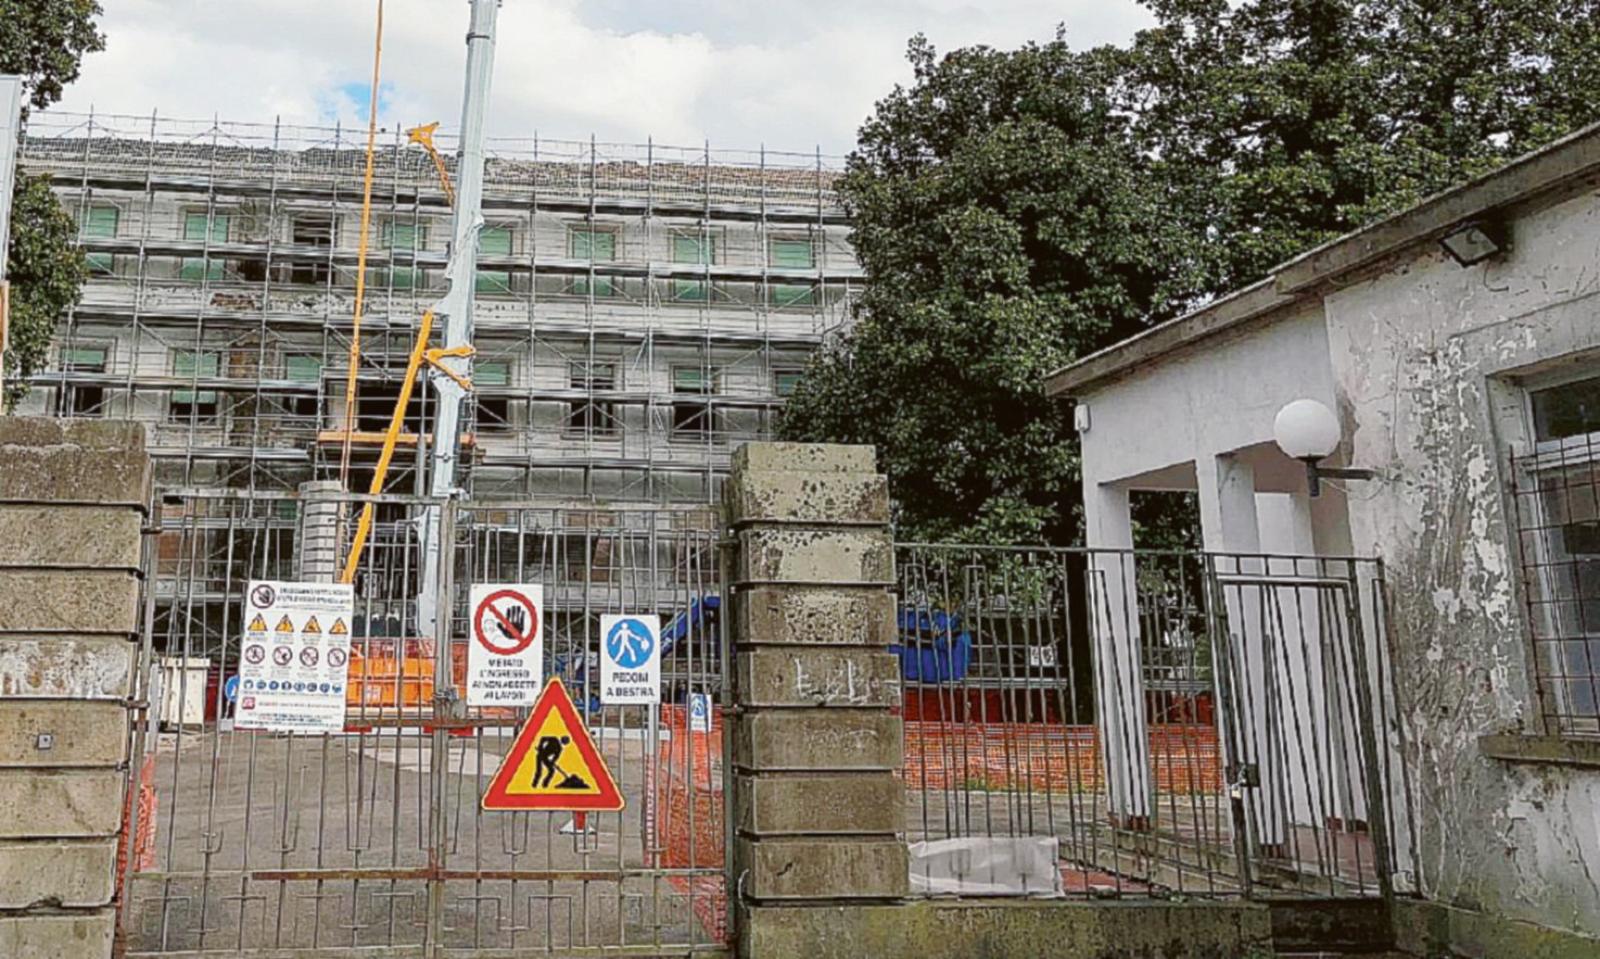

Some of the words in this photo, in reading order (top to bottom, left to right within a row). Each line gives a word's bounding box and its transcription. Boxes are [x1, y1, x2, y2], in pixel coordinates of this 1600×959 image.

[612, 671, 649, 683] PEDONI
[606, 687, 614, 696] A
[615, 687, 655, 696] DESTRA
